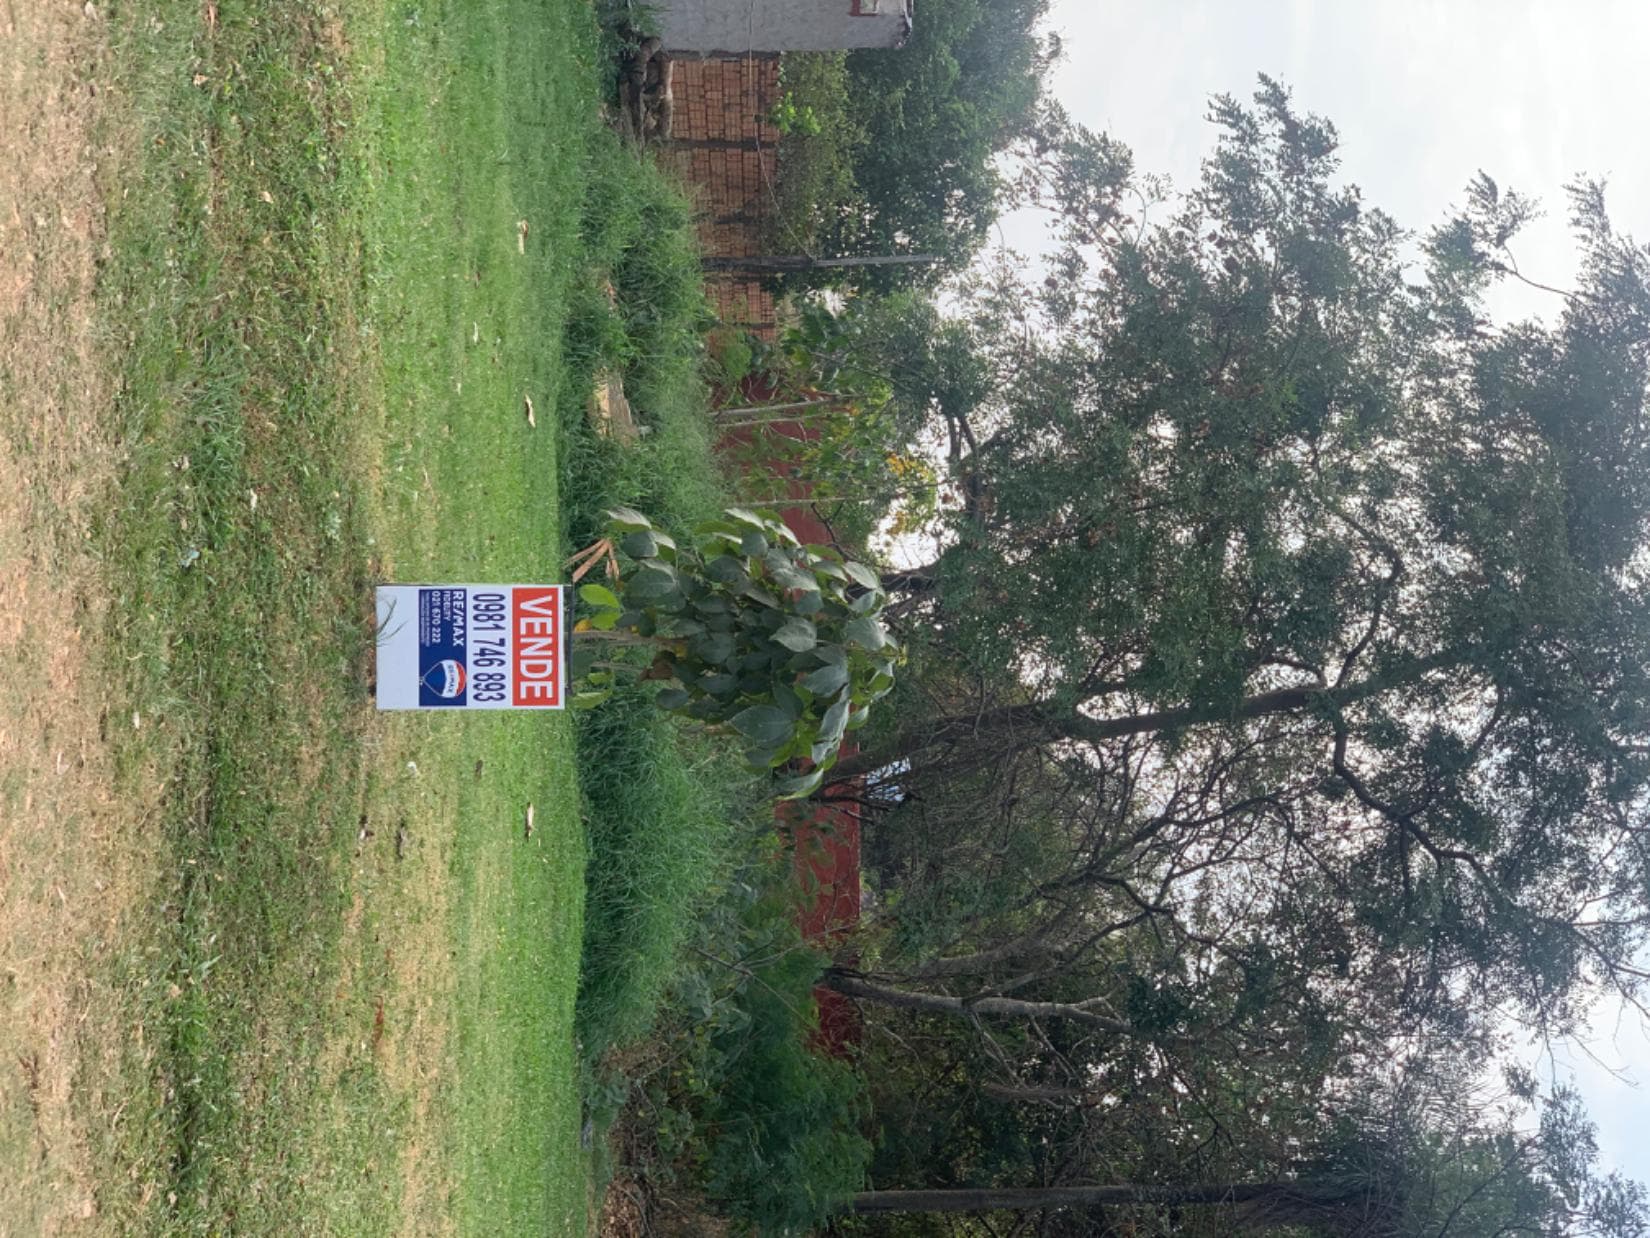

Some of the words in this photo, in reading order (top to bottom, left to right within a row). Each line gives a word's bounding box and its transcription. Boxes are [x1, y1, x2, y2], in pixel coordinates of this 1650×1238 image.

[431, 608, 441, 625] 670
[452, 591, 464, 647] RE/MAX
[473, 593, 506, 631] 0981
[431, 627, 441, 643] 222
[519, 595, 553, 700] VENDE
[473, 638, 506, 667] 746
[473, 673, 506, 702] 893
